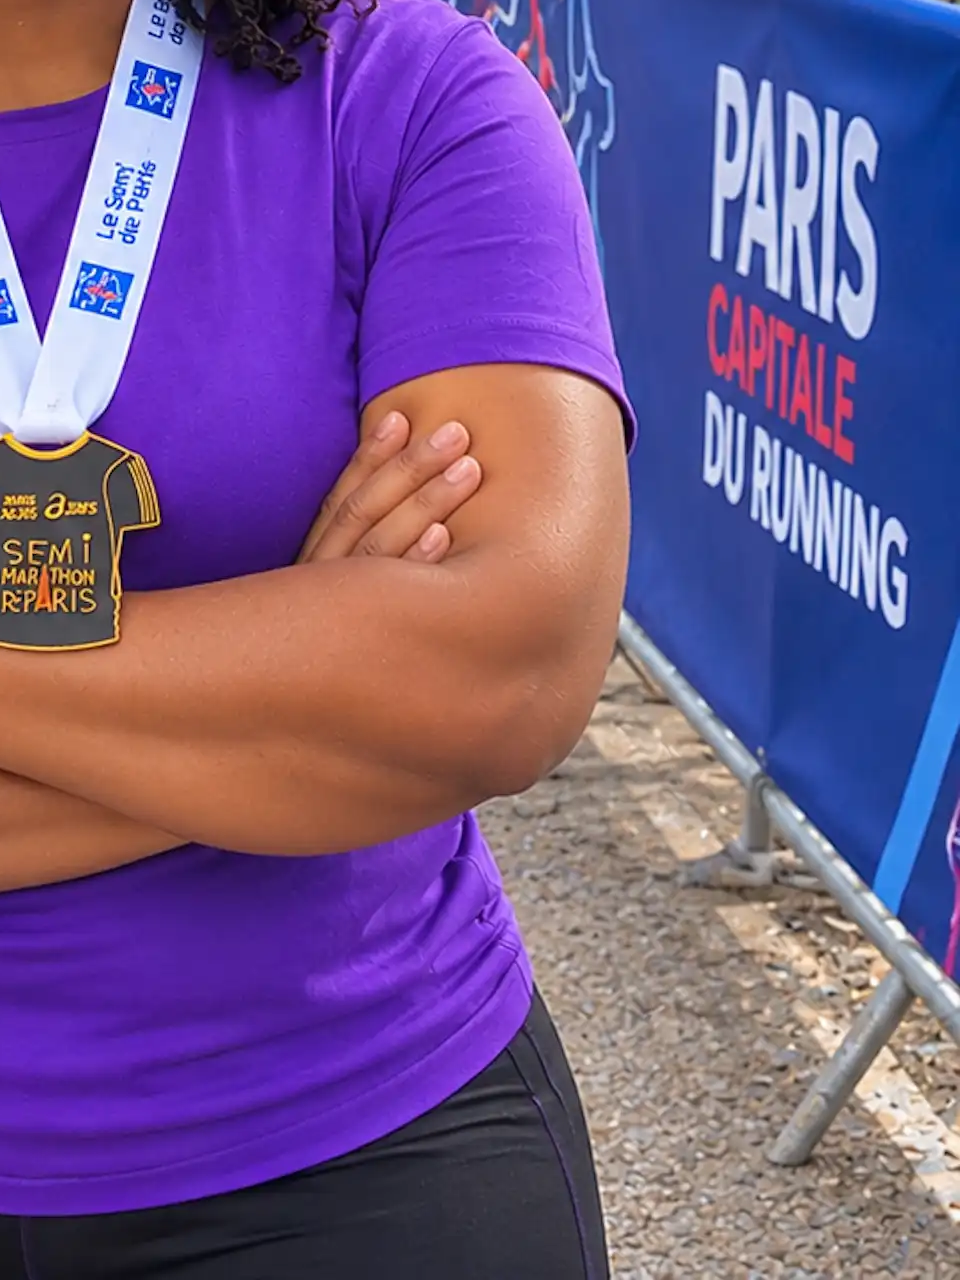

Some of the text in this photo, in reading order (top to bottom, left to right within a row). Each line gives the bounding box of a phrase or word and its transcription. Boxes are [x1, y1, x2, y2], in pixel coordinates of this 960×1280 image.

[709, 64, 879, 340] PARIS
[706, 282, 857, 464] CAPITALE
[703, 390, 909, 629] DU RUNNING
